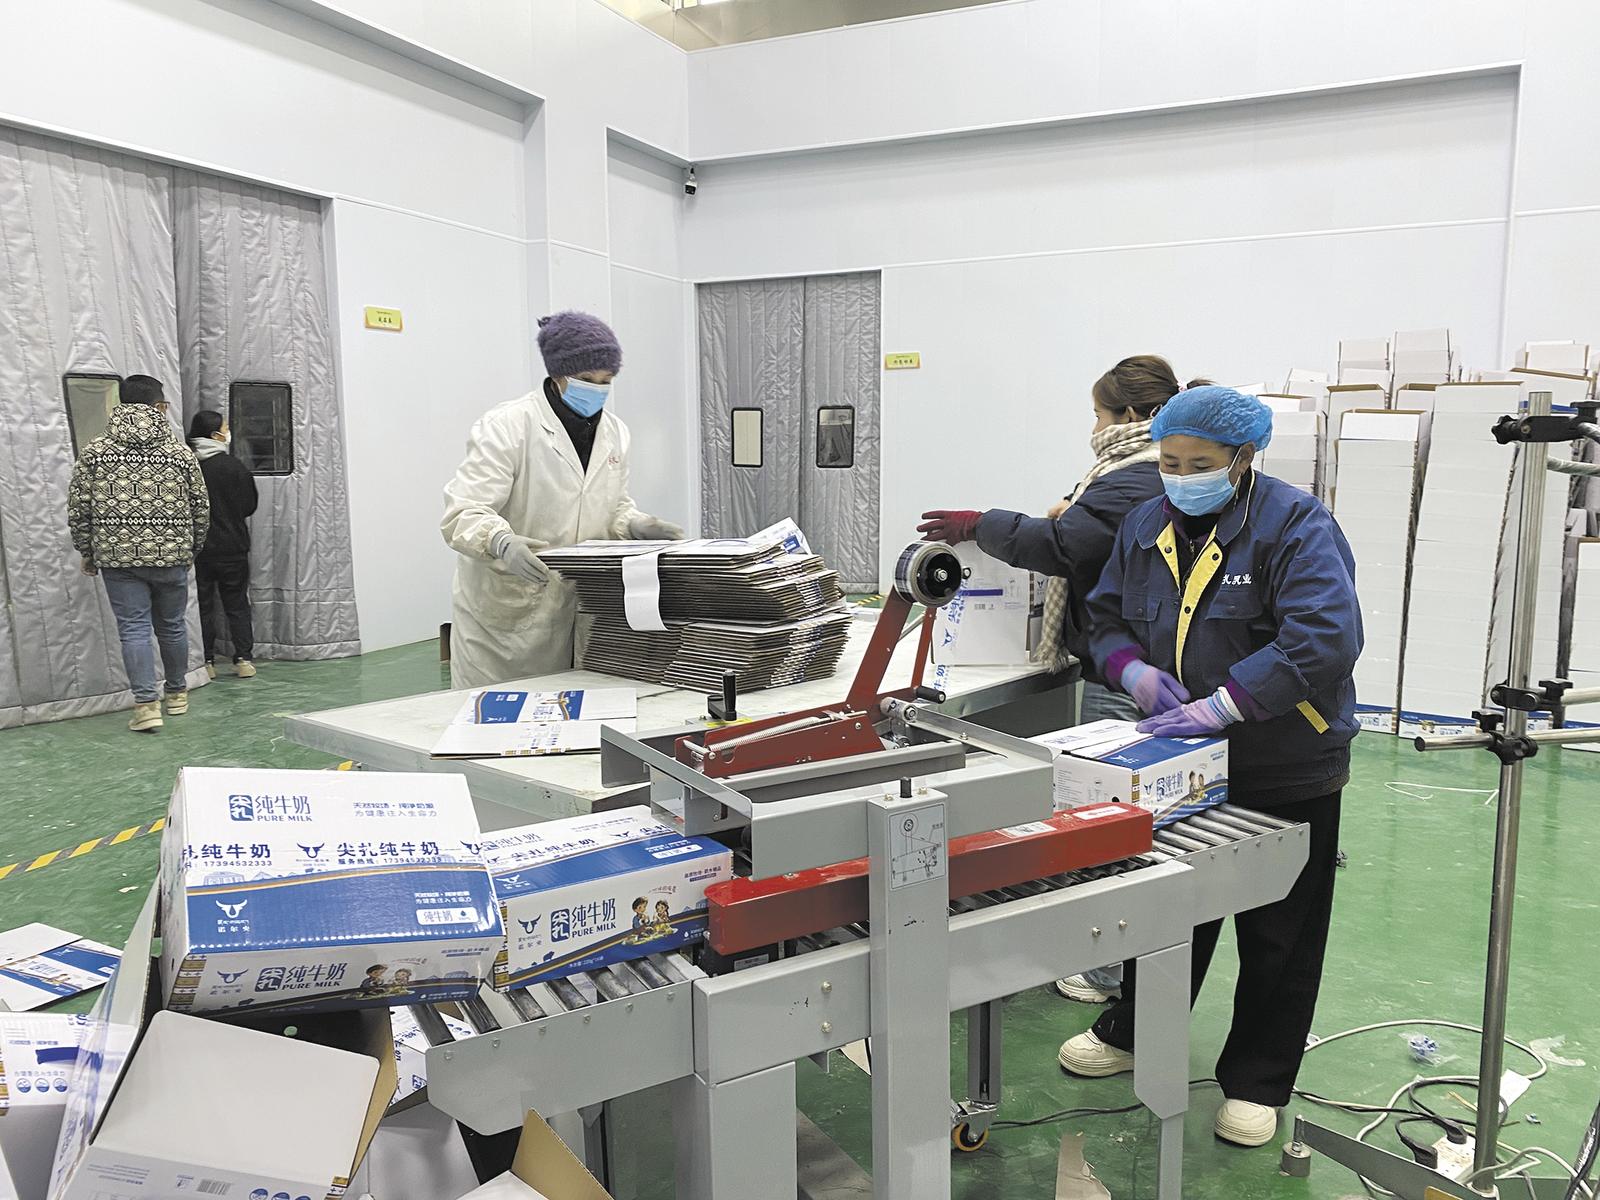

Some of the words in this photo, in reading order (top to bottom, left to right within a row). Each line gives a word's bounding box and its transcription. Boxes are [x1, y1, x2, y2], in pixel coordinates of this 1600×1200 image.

[255, 795, 311, 814] 纯牛奶
[337, 841, 439, 857] 尖扎纯牛奶
[571, 898, 616, 929] 纯牛奶
[571, 928, 595, 938] PURE
[596, 922, 617, 933] MILK
[286, 962, 347, 983] 纯牛奶
[281, 983, 311, 991] PURE
[315, 980, 341, 988] MILK
